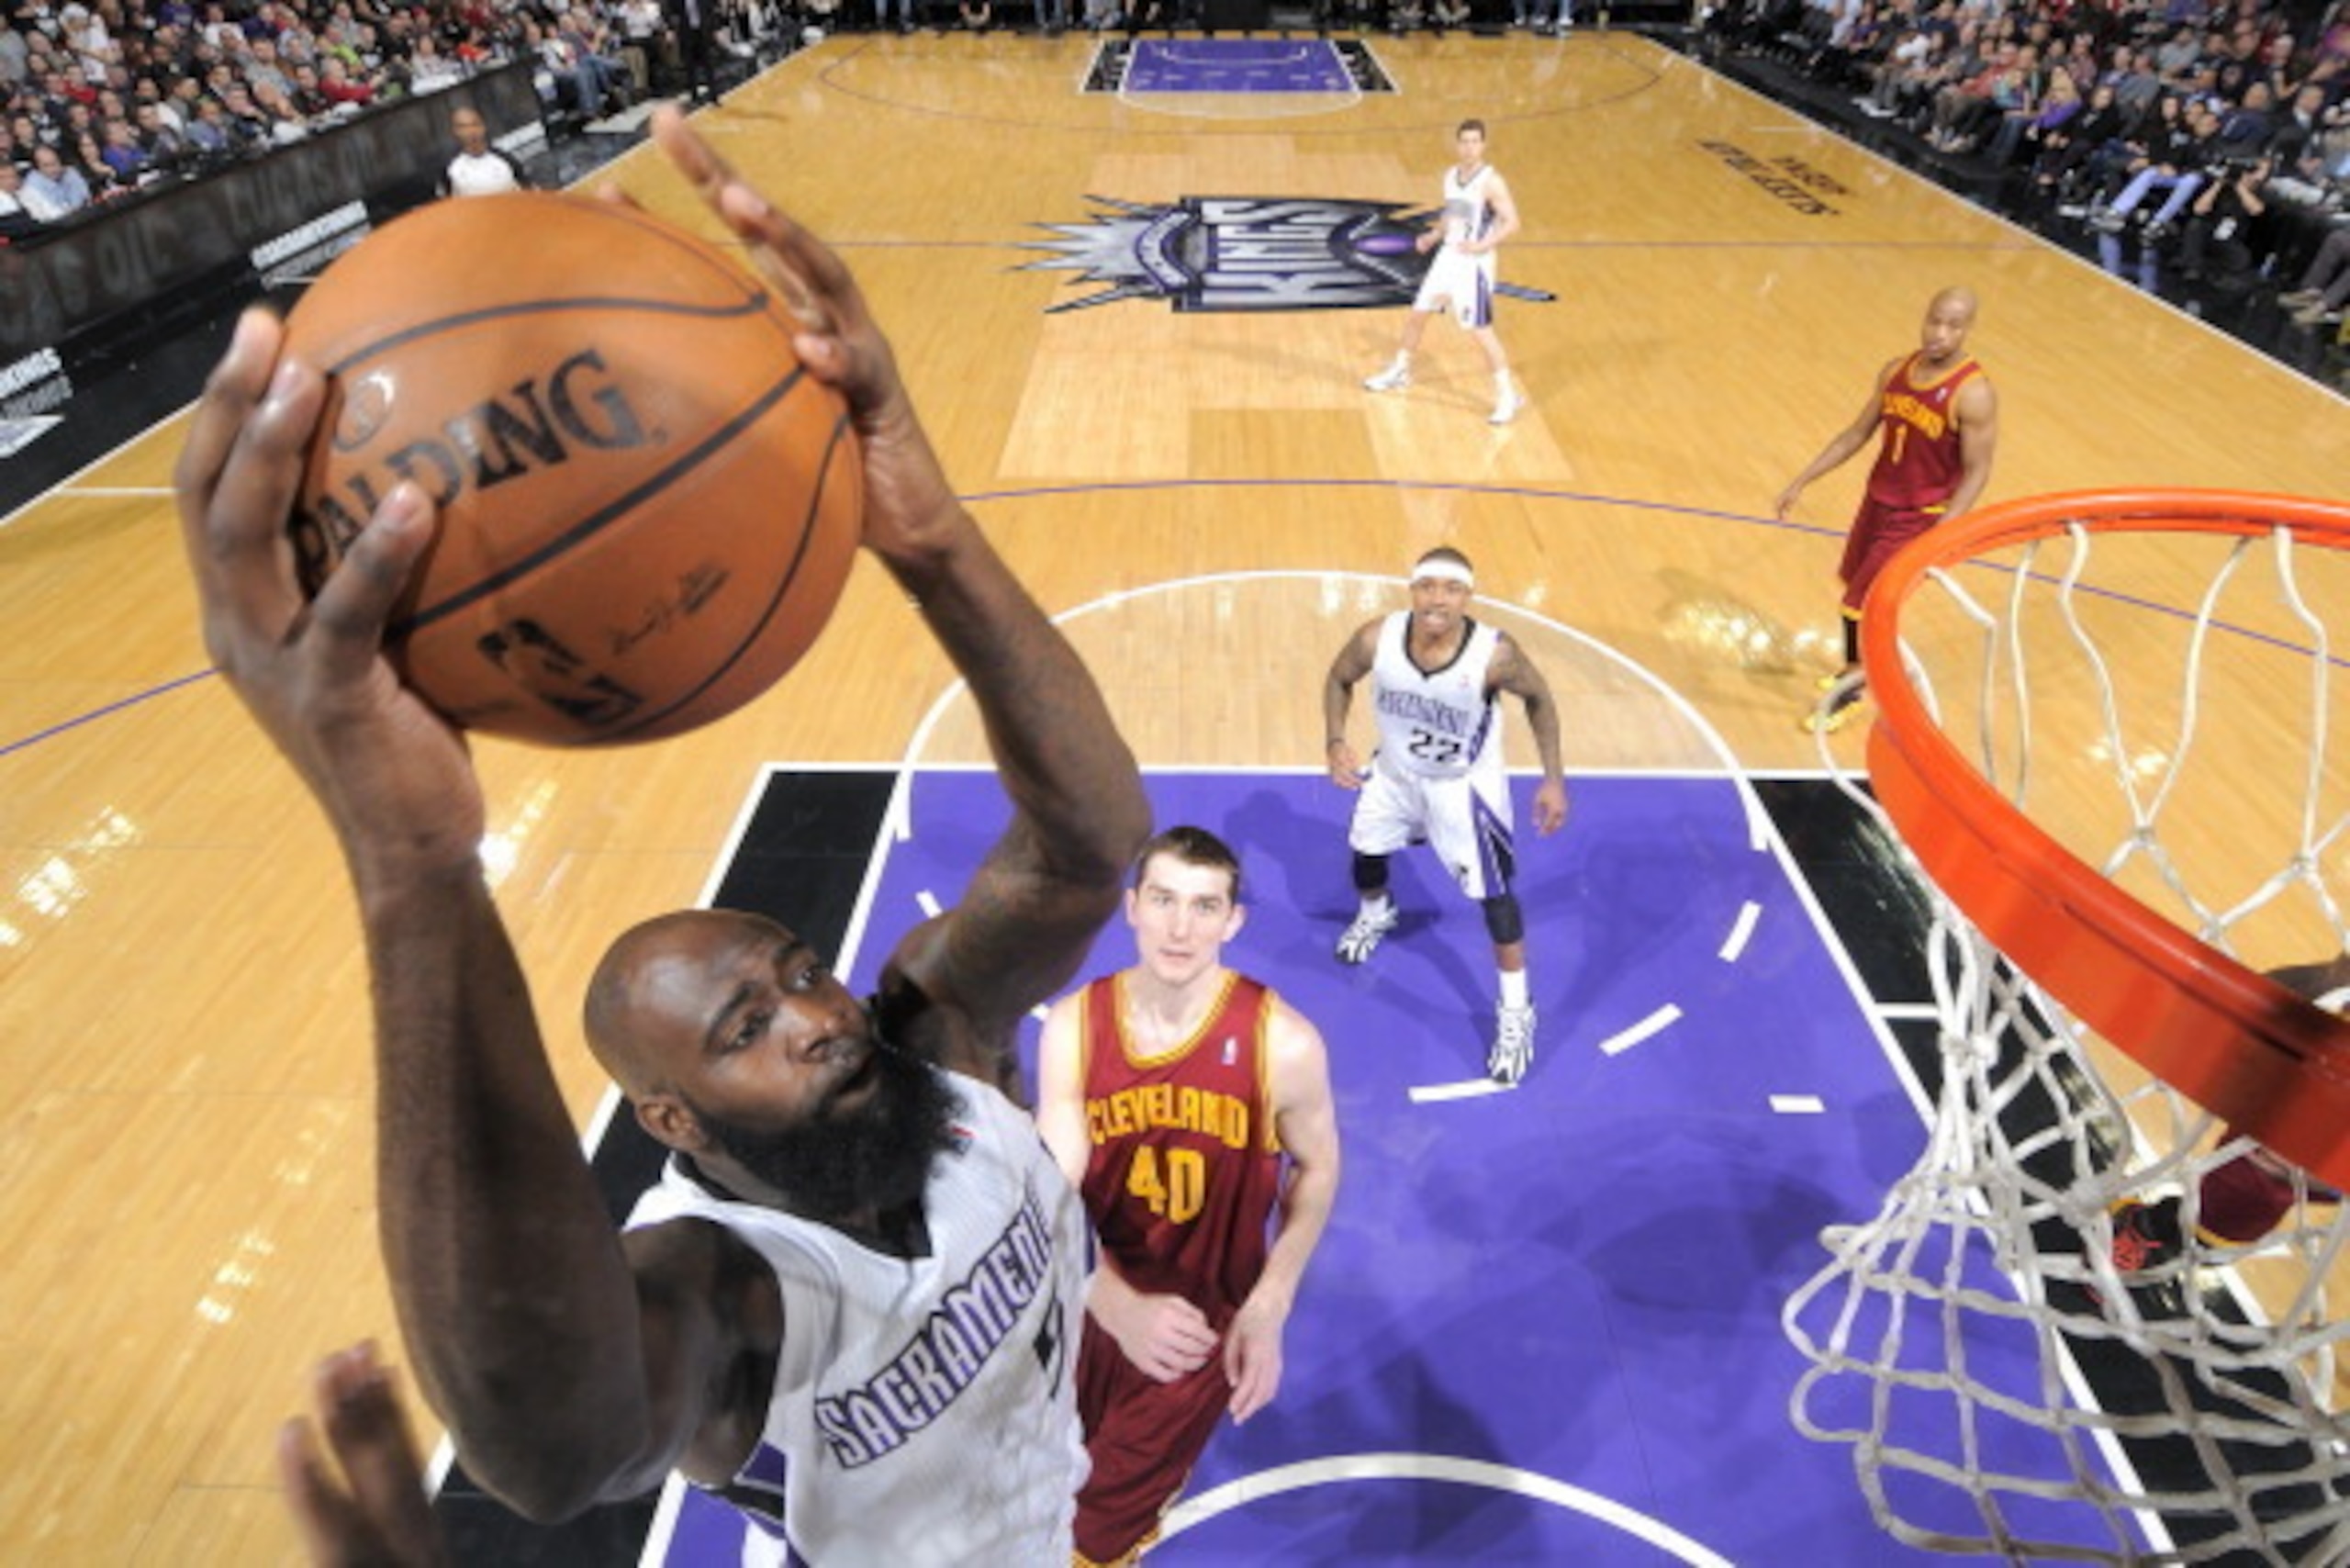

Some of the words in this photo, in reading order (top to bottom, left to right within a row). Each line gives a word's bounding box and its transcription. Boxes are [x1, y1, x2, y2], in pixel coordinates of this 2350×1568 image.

[95, 213, 173, 296] OIL
[1200, 197, 1382, 306] KINGS
[1892, 422, 1908, 466] 1
[1407, 726, 1461, 762] 22
[1086, 1082, 1249, 1149] CLEVELAND
[1126, 1145, 1204, 1225] 40
